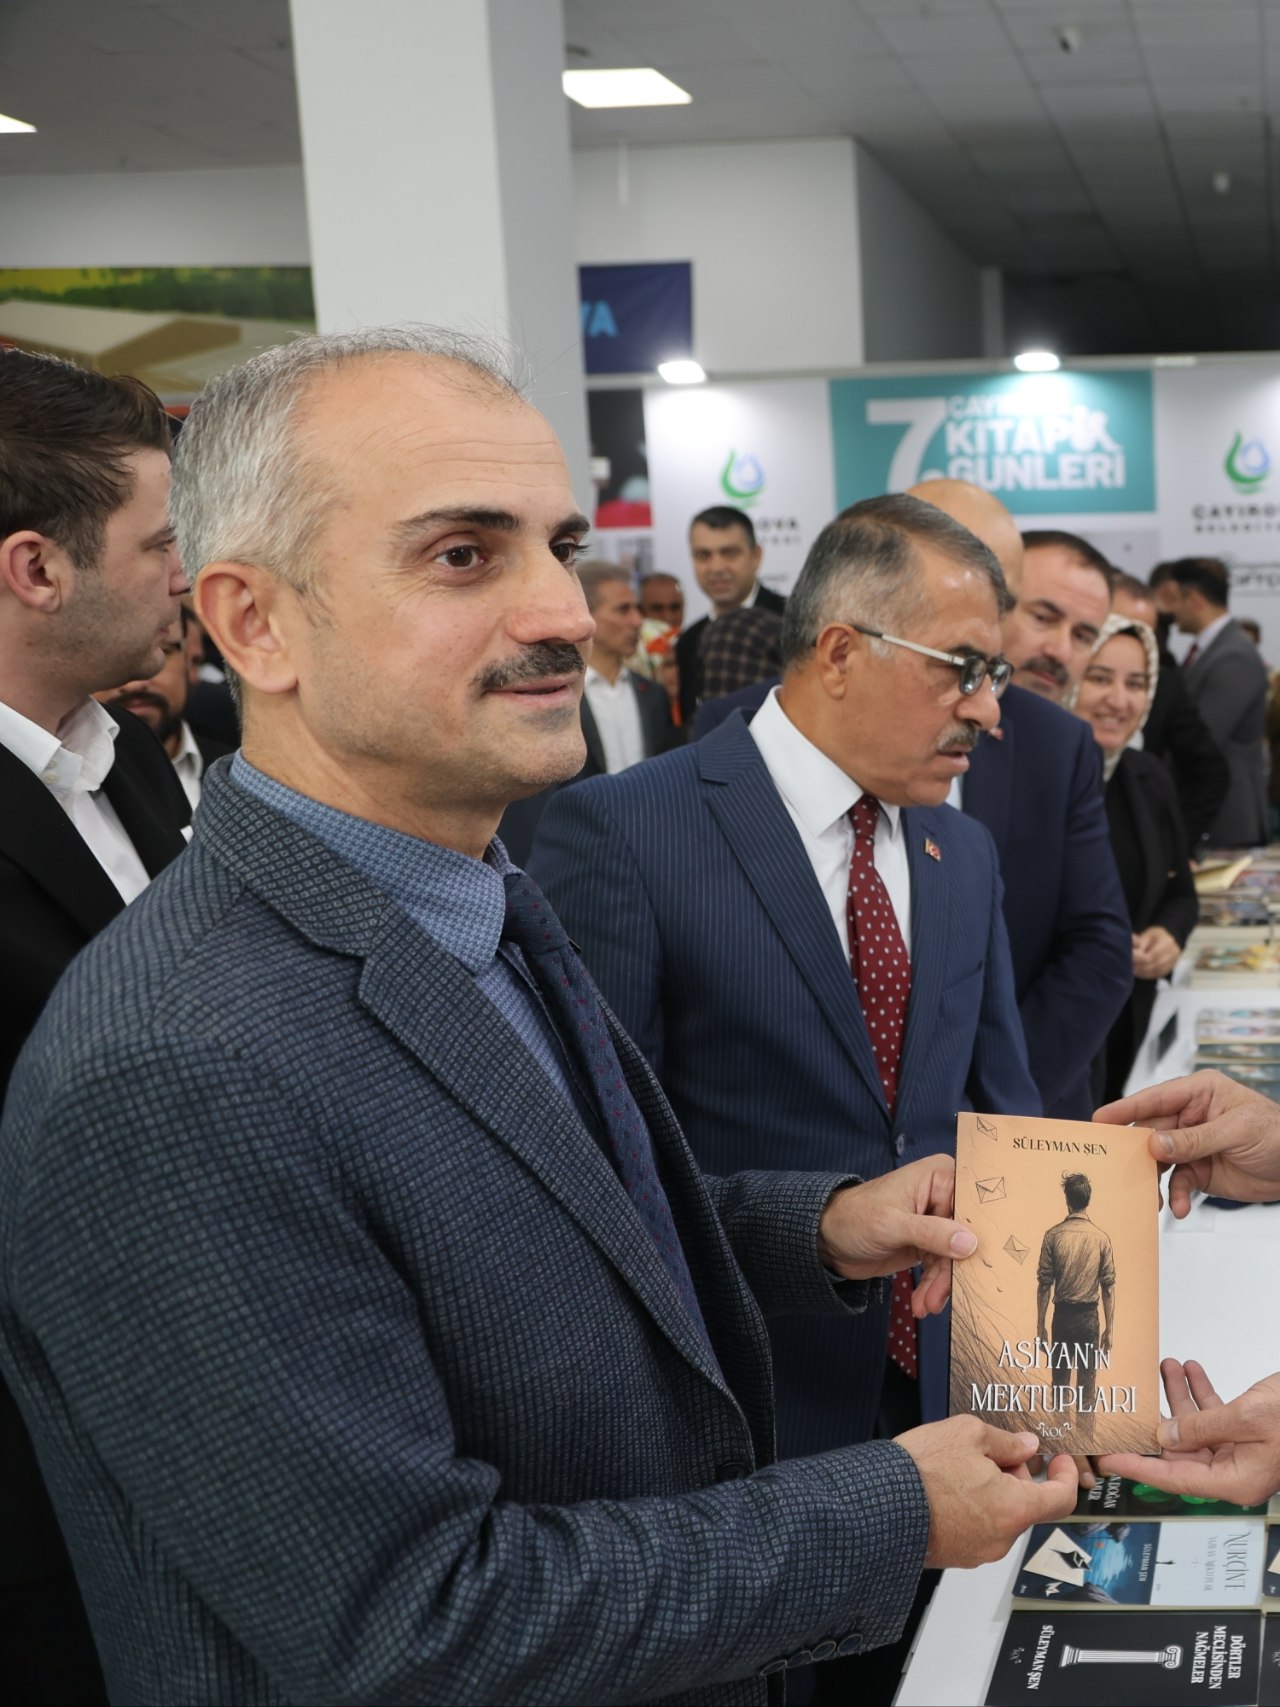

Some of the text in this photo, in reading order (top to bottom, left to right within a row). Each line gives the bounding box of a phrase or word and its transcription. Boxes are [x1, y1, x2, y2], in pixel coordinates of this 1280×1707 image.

[1013, 1136, 1107, 1156] SÜLEYMAN ŞEN
[971, 1383, 1137, 1413] MEKTUPLARI
[1138, 1543, 1152, 1582] SÜLEYMAN ŞEN
[1027, 1624, 1055, 1690] SÜLEYMAN ŞEN
[1191, 1631, 1209, 1684] NAĞMELER
[1208, 1625, 1227, 1690] MECLİSİNDEN
[1228, 1635, 1244, 1679] DÖRTLER
